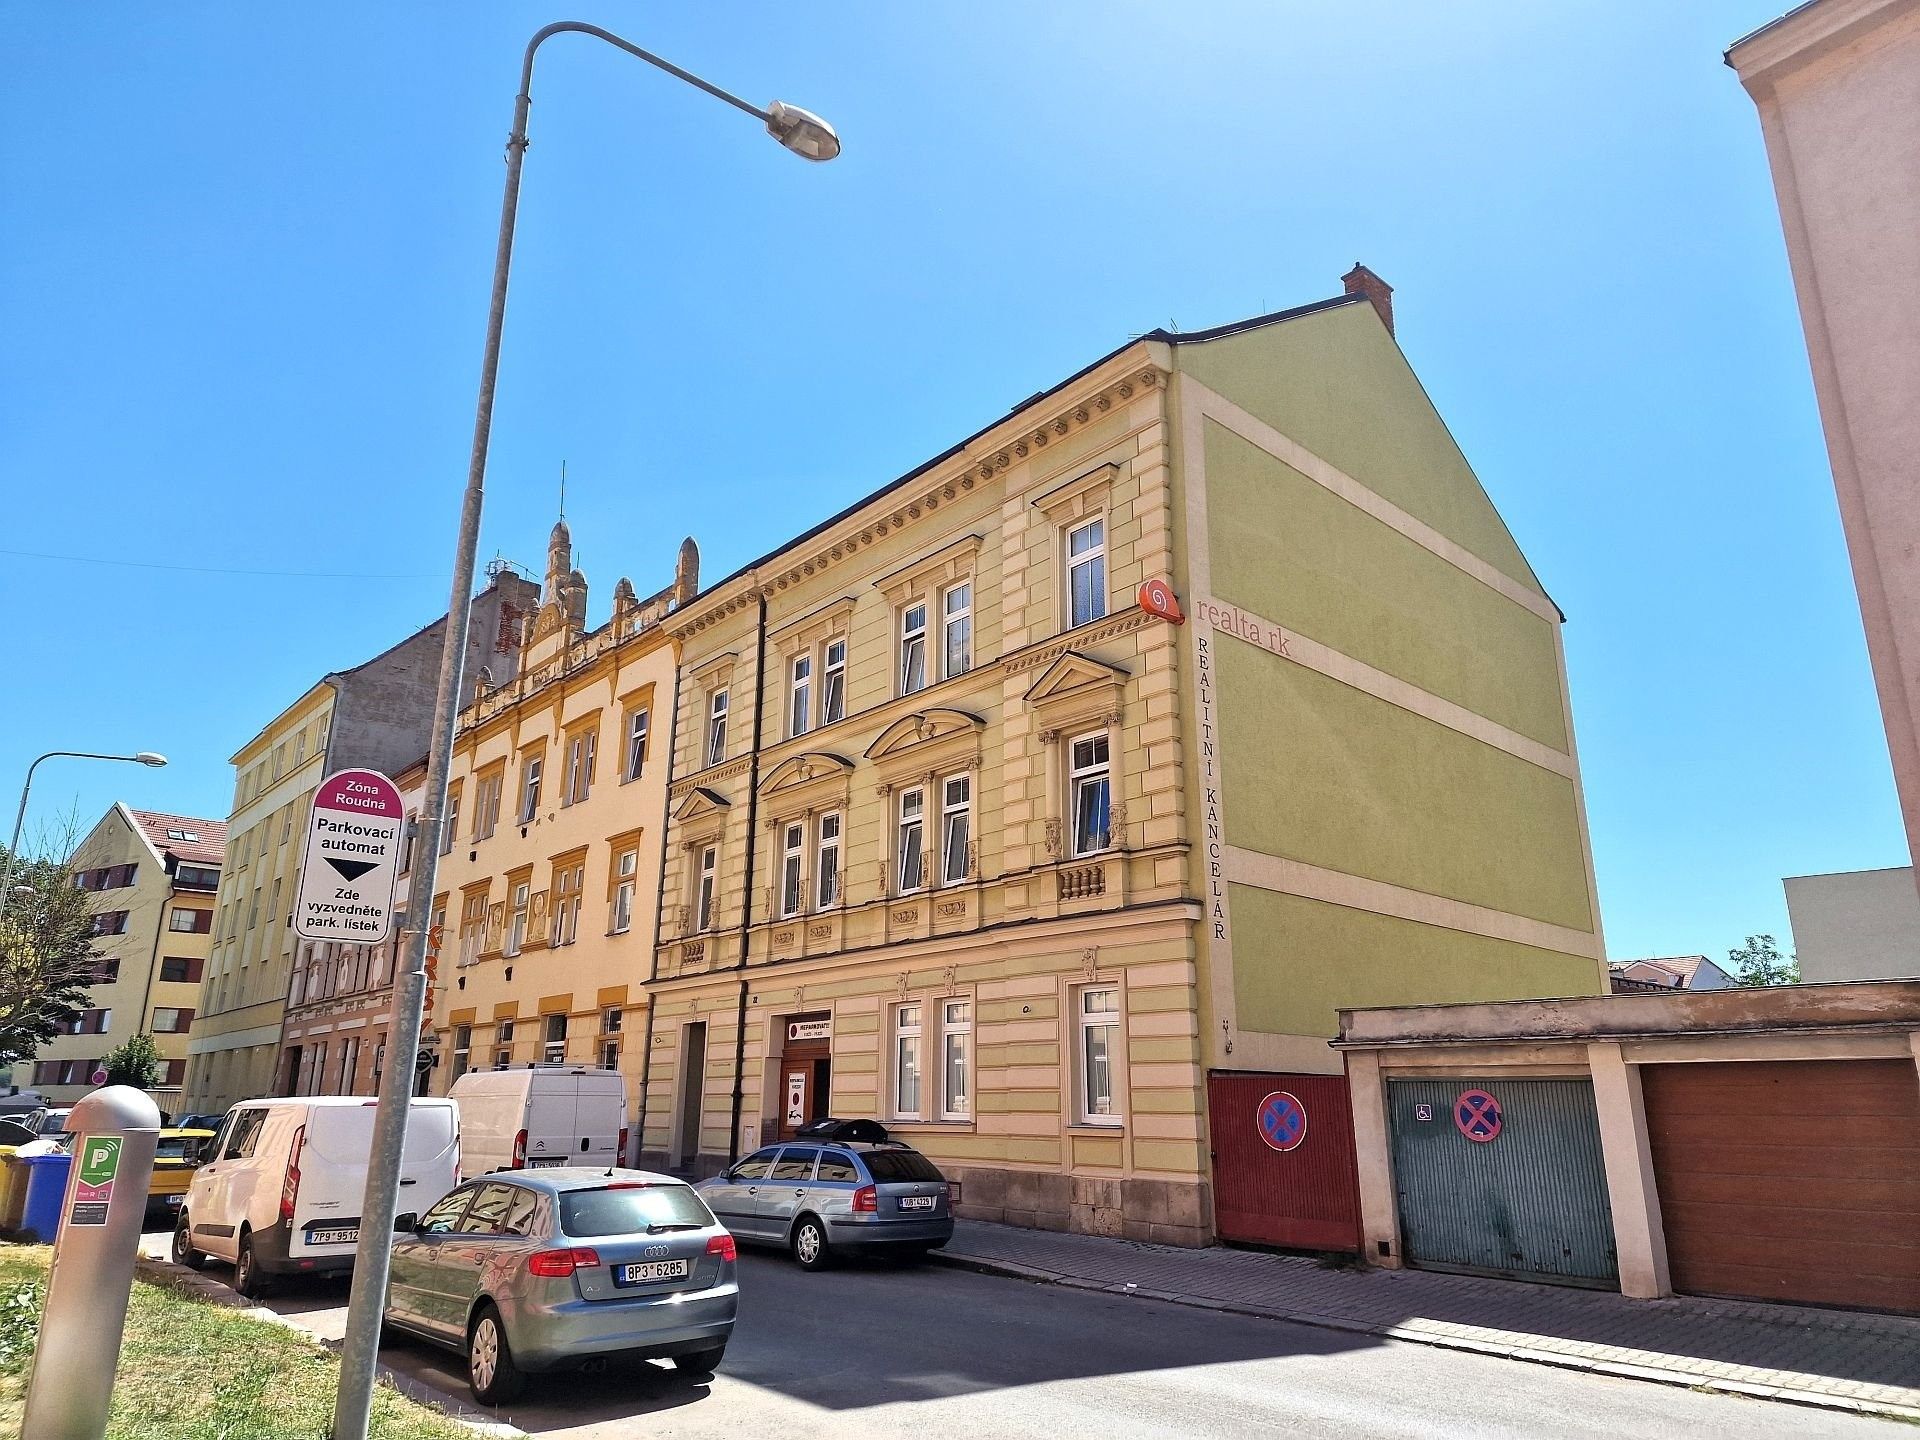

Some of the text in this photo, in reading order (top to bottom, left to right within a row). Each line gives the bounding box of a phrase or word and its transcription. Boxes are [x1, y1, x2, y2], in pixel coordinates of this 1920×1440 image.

[1197, 601, 1291, 657] realta rk
[346, 780, 379, 795] Zóna
[1199, 638, 1225, 939] REALITNÍ KANCELÁŘ
[335, 793, 386, 810] Roudná
[317, 817, 394, 840] Parkovací
[321, 838, 385, 855] automat
[334, 888, 360, 900] Zde
[307, 902, 382, 917] vyzvedněte
[306, 917, 379, 931] park. lístek
[314, 1231, 359, 1242] 7P9 9512
[628, 1266, 648, 1280] 8P3
[656, 1261, 683, 1276] 6285
